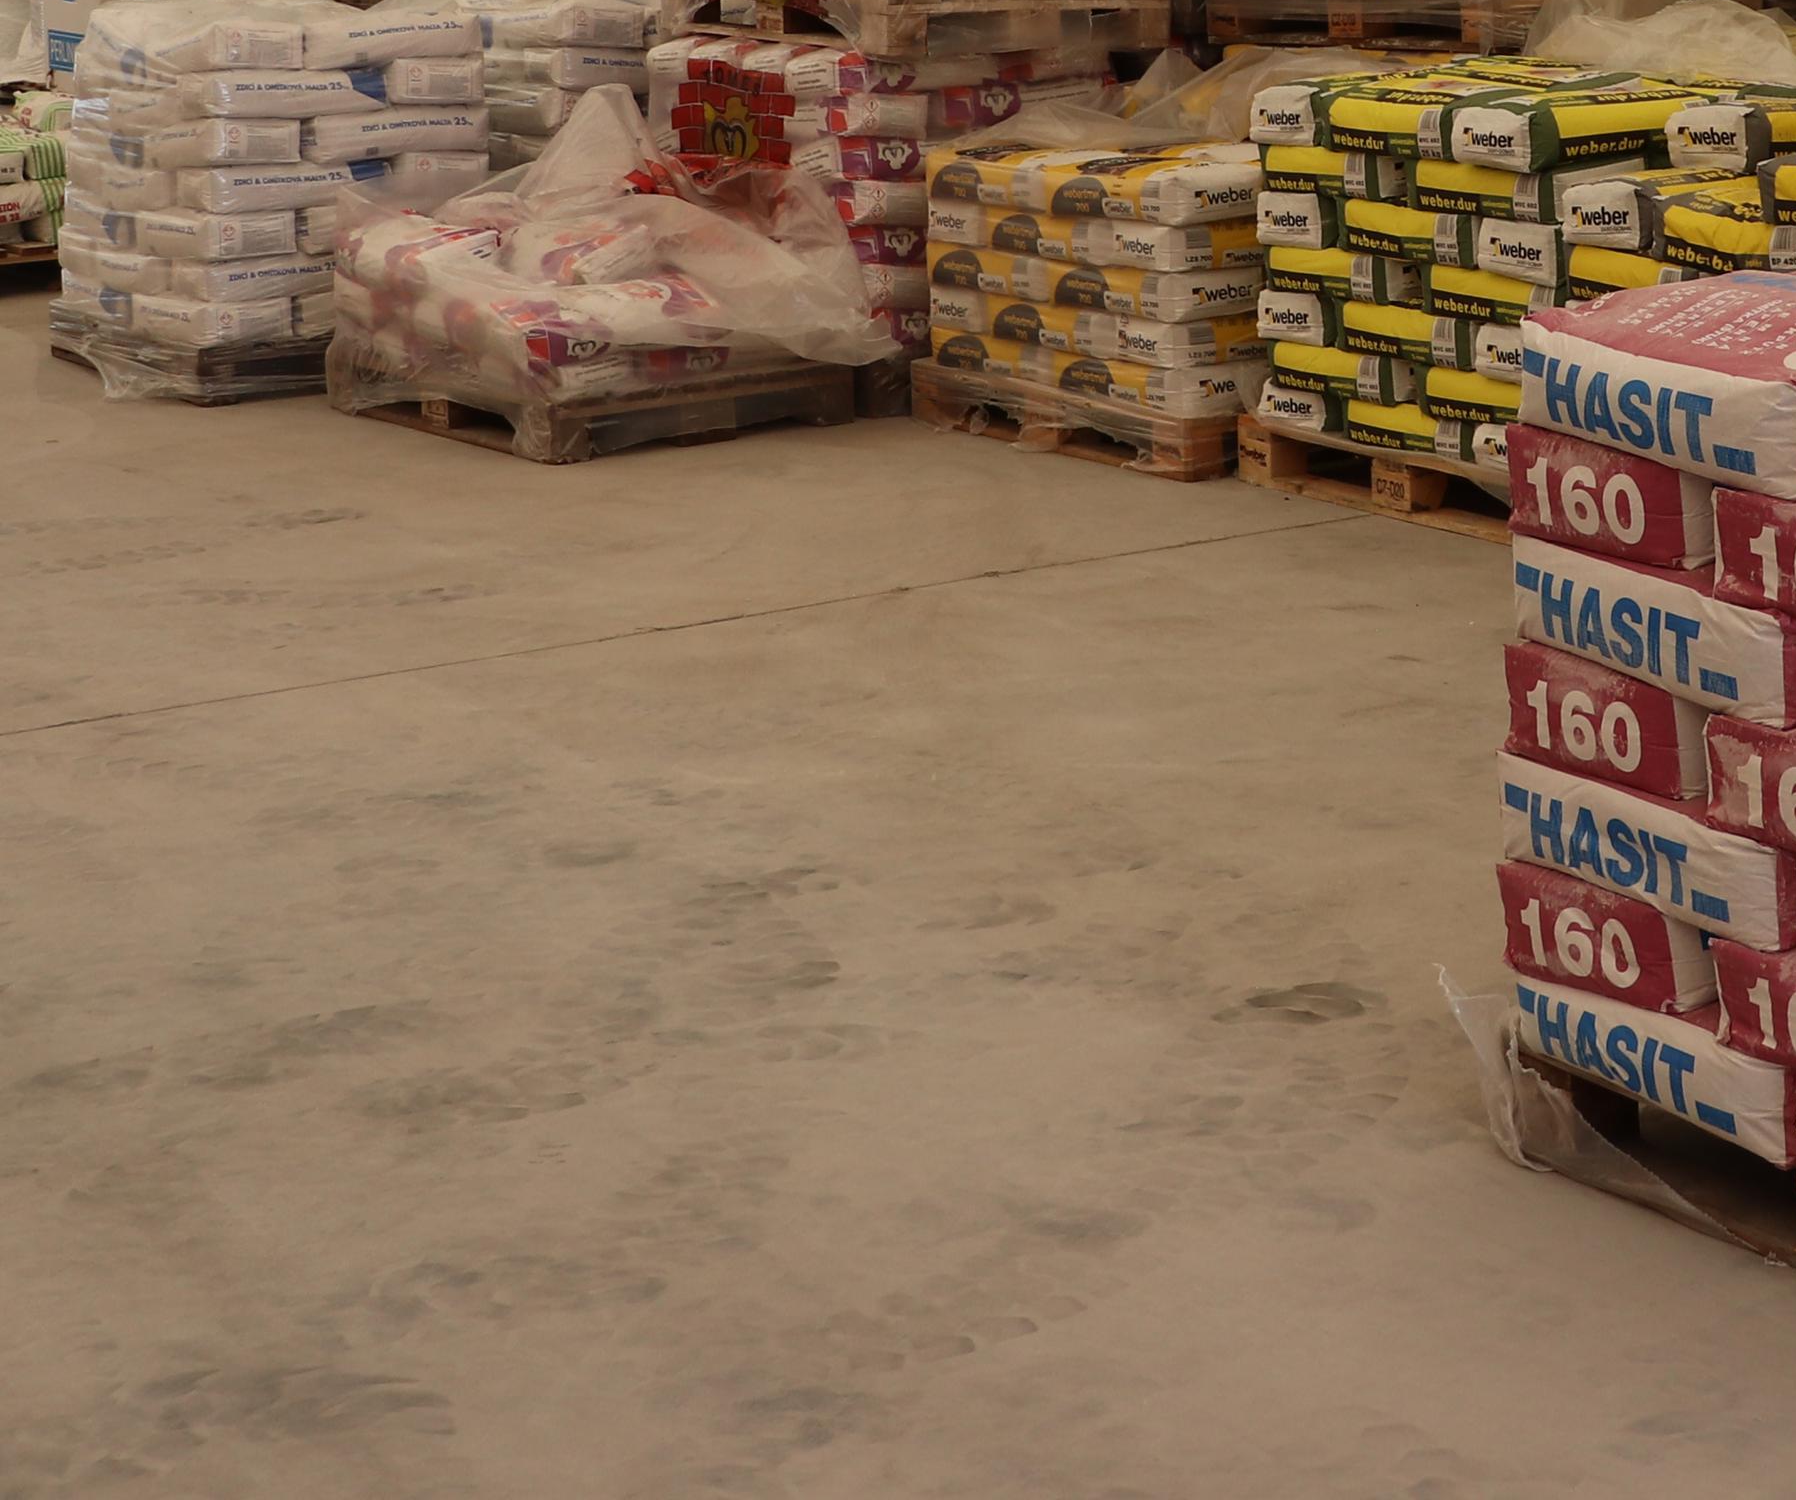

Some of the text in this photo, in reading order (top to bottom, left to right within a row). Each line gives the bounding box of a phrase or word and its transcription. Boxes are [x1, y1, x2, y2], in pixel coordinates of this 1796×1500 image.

[454, 117, 468, 126] 25
[1266, 109, 1300, 126] weber
[1333, 132, 1384, 150] weber.dur
[1471, 130, 1514, 148] weber
[1689, 127, 1736, 146] weber
[1565, 137, 1645, 157] weber.dur
[1269, 178, 1316, 190] weber.dur
[1207, 188, 1253, 204] weber
[1420, 194, 1478, 212] weber.dur
[1272, 211, 1308, 228] weber
[1581, 206, 1629, 226] weber
[1122, 238, 1155, 255] weber
[1350, 233, 1400, 252] weber.dur
[1499, 242, 1542, 262] weber
[1206, 284, 1253, 301] weber
[1271, 308, 1308, 326] weber
[1434, 296, 1492, 318] weber.dur
[1347, 334, 1398, 356] weber.dur
[1496, 345, 1522, 366] web
[1277, 373, 1326, 393] weber.dur
[1272, 399, 1312, 416] weber
[1430, 402, 1492, 423] weber.dur
[1544, 355, 1712, 461] HASIT
[1526, 457, 1645, 544] 160
[1539, 570, 1700, 677] HASIT
[1525, 680, 1642, 773] 160
[1530, 796, 1687, 907] HASIT
[1521, 898, 1639, 988] 160
[1534, 996, 1695, 1120] HASIT
